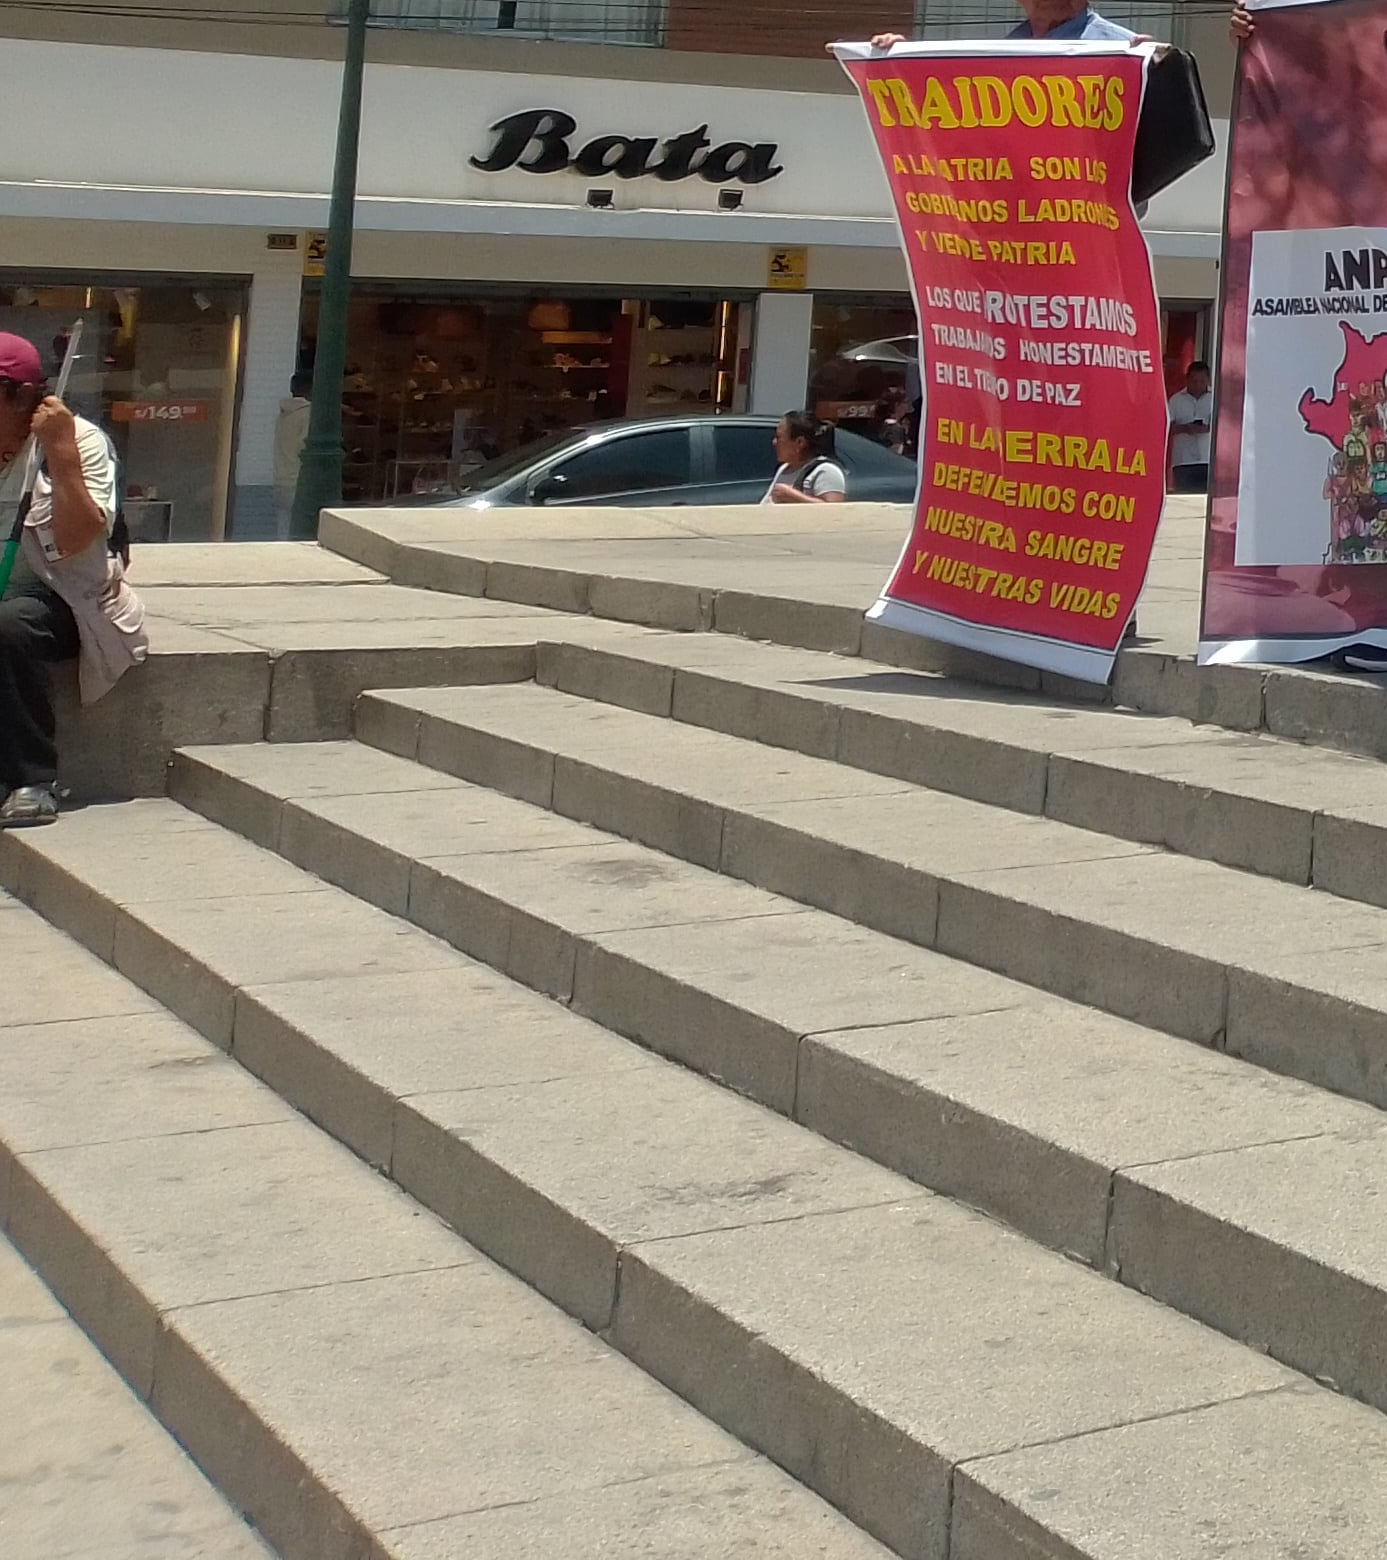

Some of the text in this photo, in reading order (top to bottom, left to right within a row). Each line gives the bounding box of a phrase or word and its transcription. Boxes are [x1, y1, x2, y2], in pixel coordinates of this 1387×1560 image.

[866, 75, 1124, 131] TRAIDORES
[470, 108, 784, 184] Bata
[893, 154, 908, 174] A
[909, 154, 936, 176] LA
[937, 156, 1014, 181] ATRIA
[1030, 156, 1082, 180] SON
[905, 192, 1009, 224] GOBINOS
[915, 229, 928, 251] Y
[988, 240, 1077, 265] PATRIA
[926, 286, 1138, 336] LOS QUE ROTESTAMOS
[1252, 297, 1320, 316] ASAMBLEA
[1321, 295, 1370, 315] NACIONAL
[931, 323, 1154, 373] TRABAJOS HONESTAMENTE
[935, 362, 954, 385] EN
[956, 366, 973, 389] EL
[1016, 378, 1044, 402] DE
[1044, 382, 1082, 407] PAZ
[936, 417, 1147, 477] EN LA ERRA LA
[932, 461, 1137, 523] DEFENDEMOS CON
[924, 506, 1125, 571] NUESTRA SANGRE
[911, 549, 1121, 620] Y NUESTRAS VIDAS
